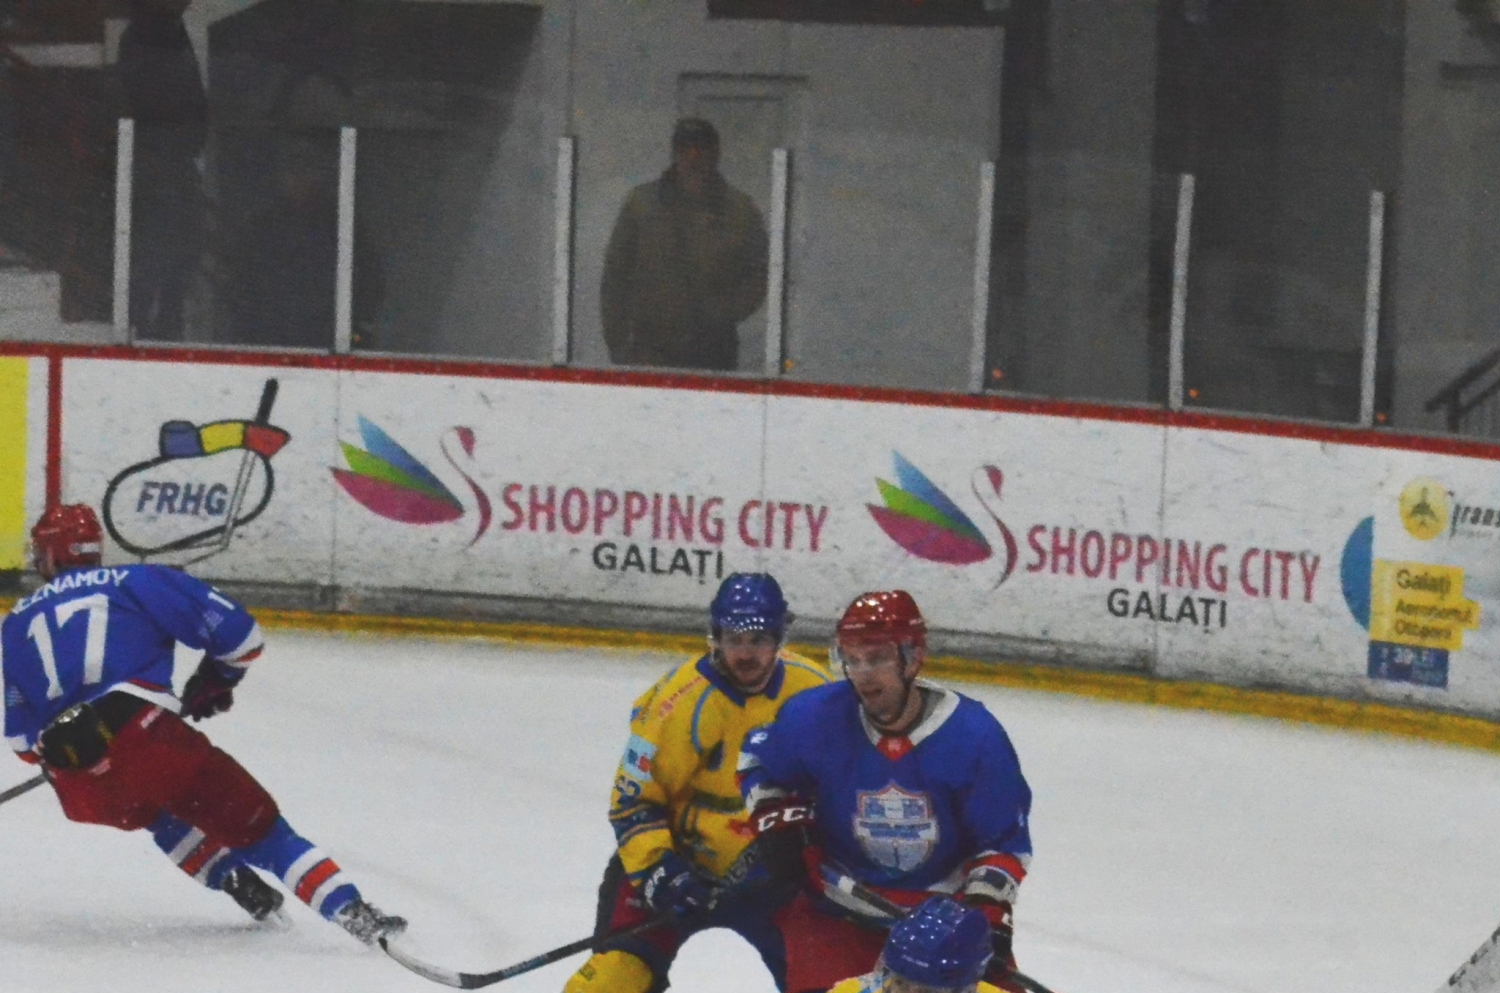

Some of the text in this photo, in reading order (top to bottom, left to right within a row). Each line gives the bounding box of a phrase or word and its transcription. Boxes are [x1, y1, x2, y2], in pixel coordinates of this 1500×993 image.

[136, 480, 229, 517] FRHG
[502, 482, 829, 553] SHOPPING CITY
[1026, 523, 1322, 604] SHOPPING CITY
[27, 592, 110, 701] 17
